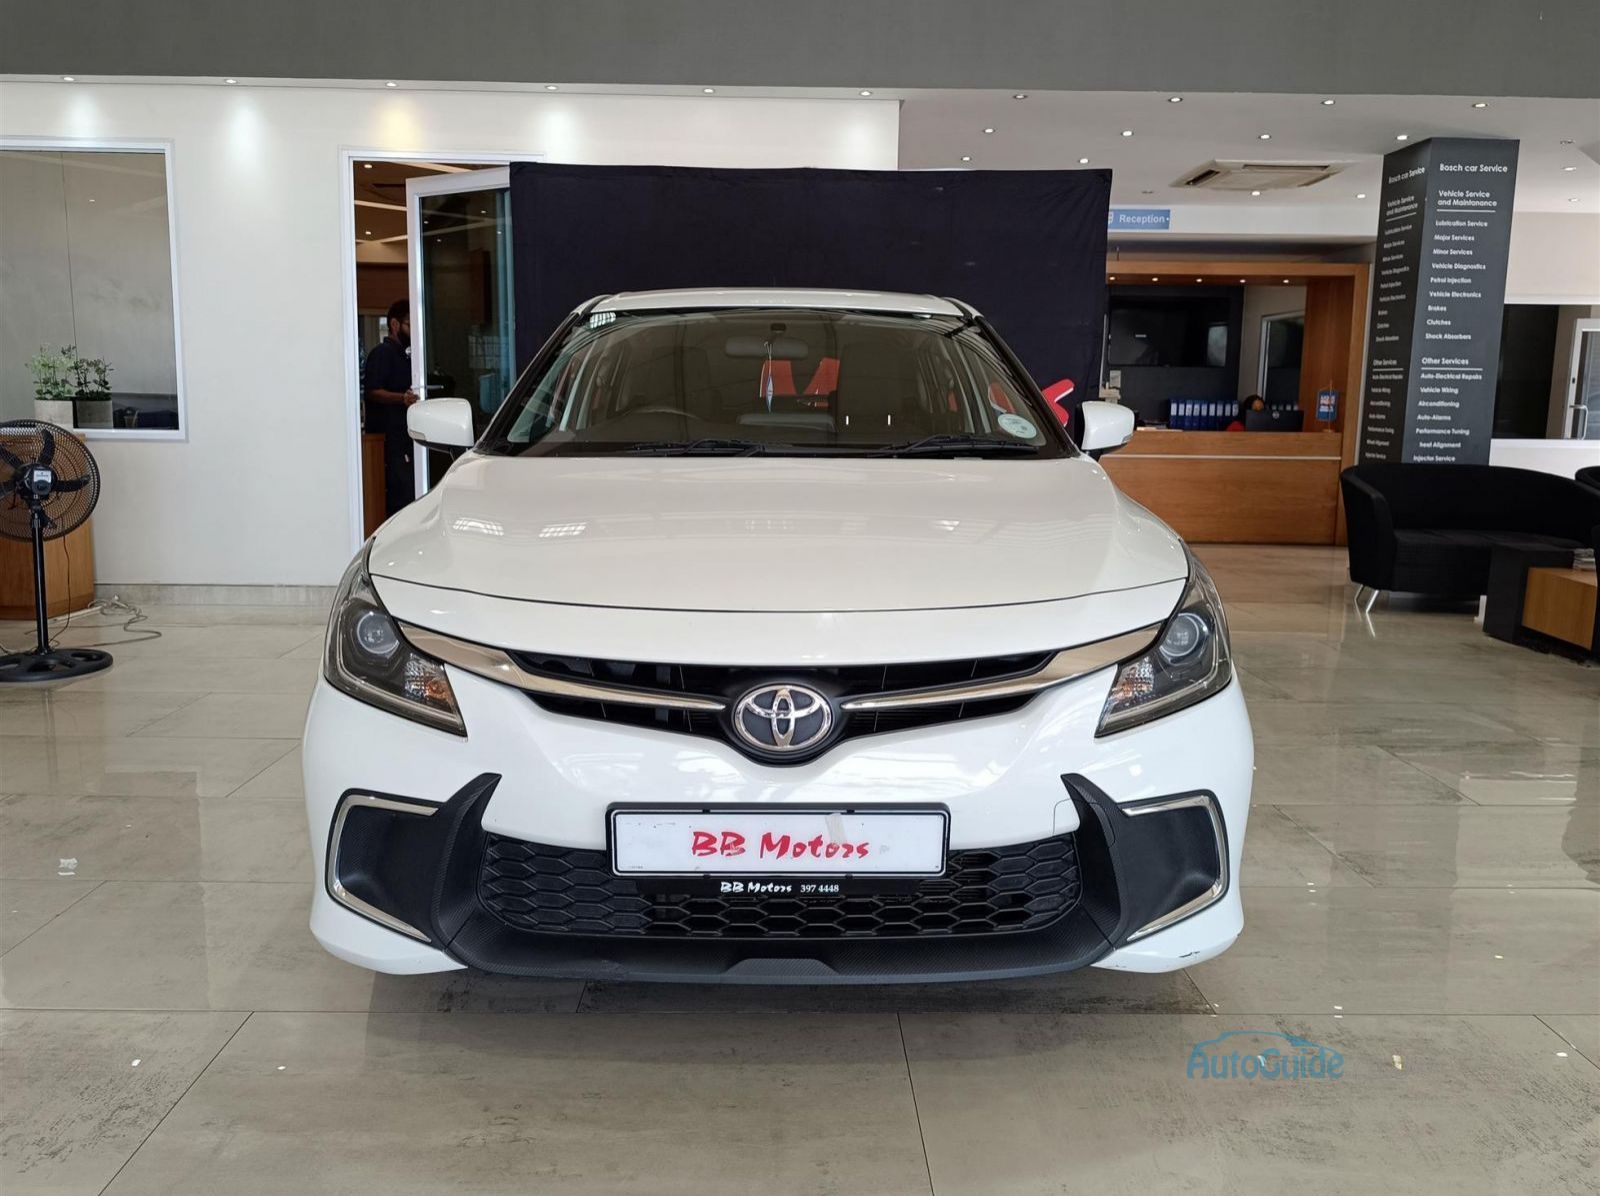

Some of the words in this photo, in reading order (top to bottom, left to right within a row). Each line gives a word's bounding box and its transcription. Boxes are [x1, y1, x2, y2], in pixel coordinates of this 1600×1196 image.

[1440, 163, 1463, 171] Bosch
[1480, 164, 1508, 172] Service
[1466, 190, 1490, 198] Service
[1119, 213, 1165, 224] Reception
[692, 831, 746, 857] BB
[760, 832, 870, 860] Motors
[720, 882, 744, 893] BB
[747, 882, 792, 894] Motors
[800, 884, 817, 893] 397
[818, 884, 840, 893] 4448
